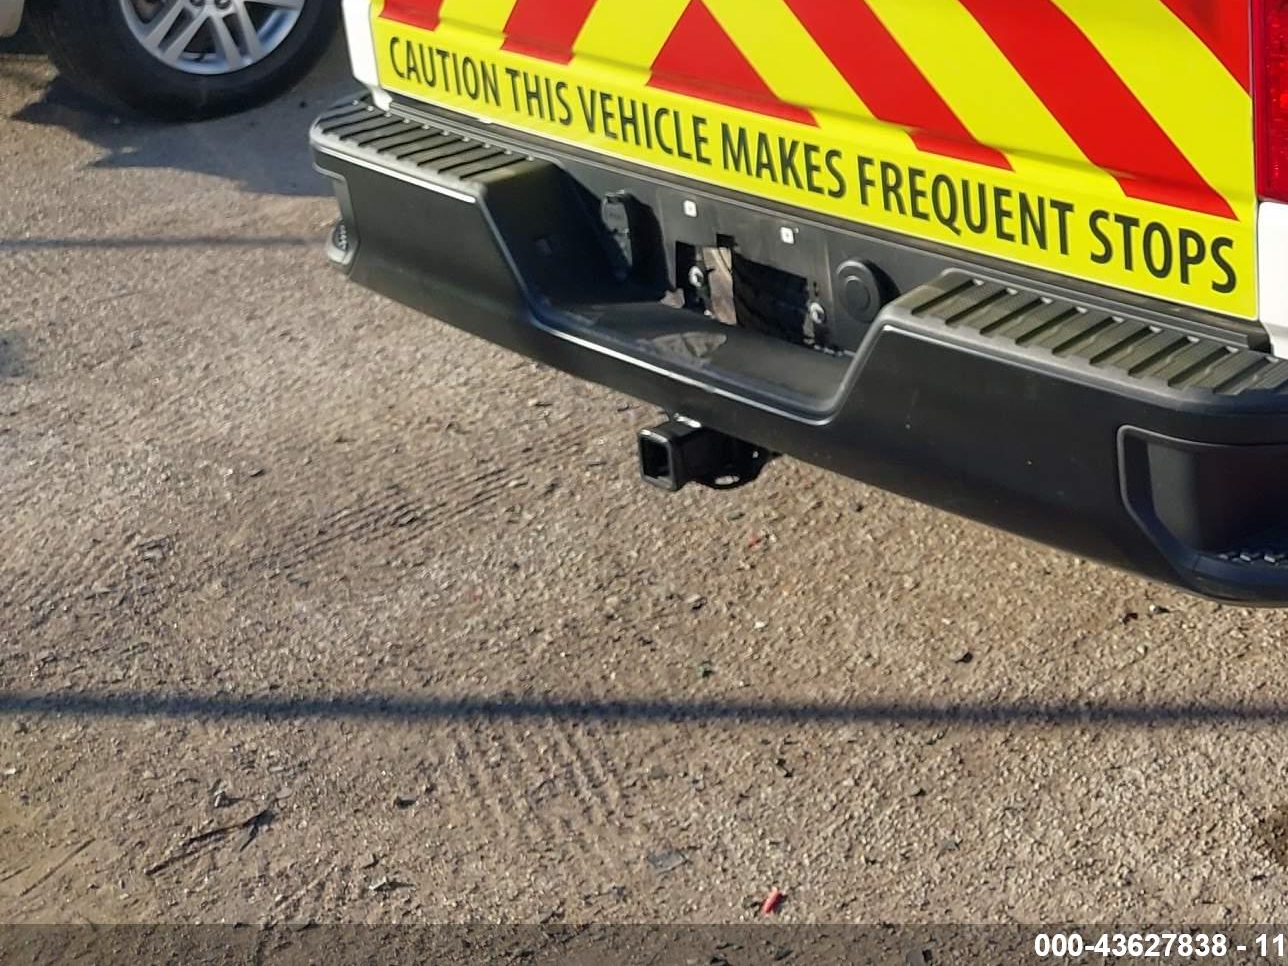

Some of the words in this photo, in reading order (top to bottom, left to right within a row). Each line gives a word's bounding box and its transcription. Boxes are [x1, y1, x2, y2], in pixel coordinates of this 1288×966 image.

[389, 36, 502, 107] CAUTION
[505, 67, 573, 125] THIS
[577, 85, 712, 165] VEHICLE
[721, 122, 846, 199] MAKES
[856, 155, 1074, 256] FREQUENT
[1088, 209, 1238, 294] STOPS
